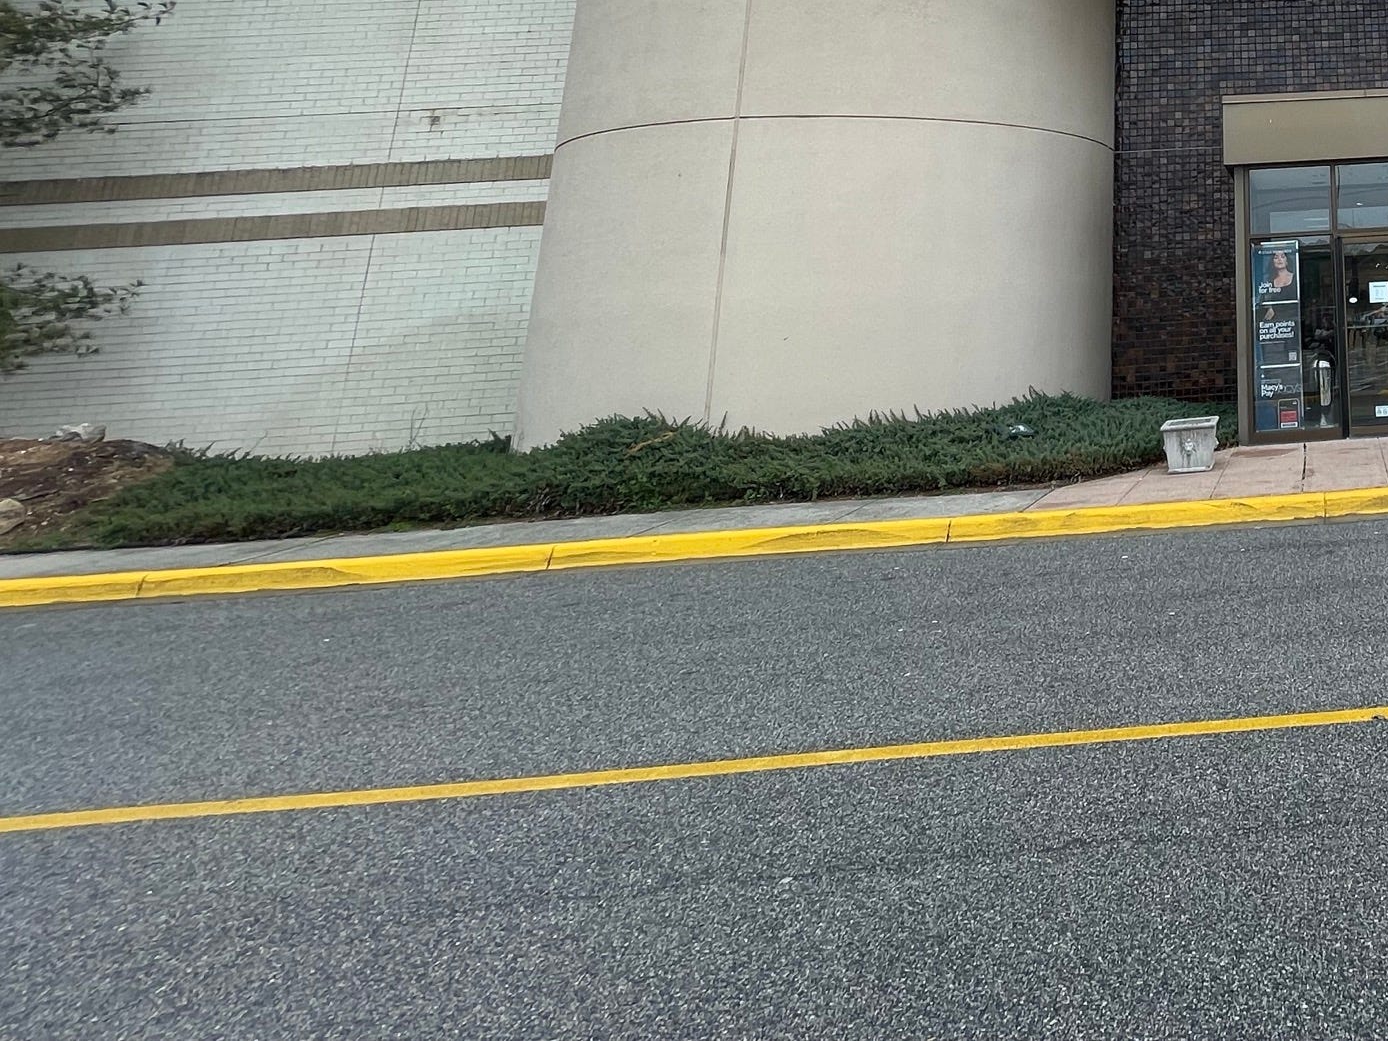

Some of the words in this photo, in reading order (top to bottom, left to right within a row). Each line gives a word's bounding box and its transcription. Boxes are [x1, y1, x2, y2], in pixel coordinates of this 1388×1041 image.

[1259, 281, 1273, 289] Join
[1259, 321, 1275, 329] Earn
[1275, 320, 1296, 329] points
[1269, 326, 1277, 334] all
[1277, 326, 1292, 334] your
[1259, 331, 1295, 341] purchases!
[1261, 383, 1283, 392] Macy's
[1261, 389, 1274, 398] Pay
